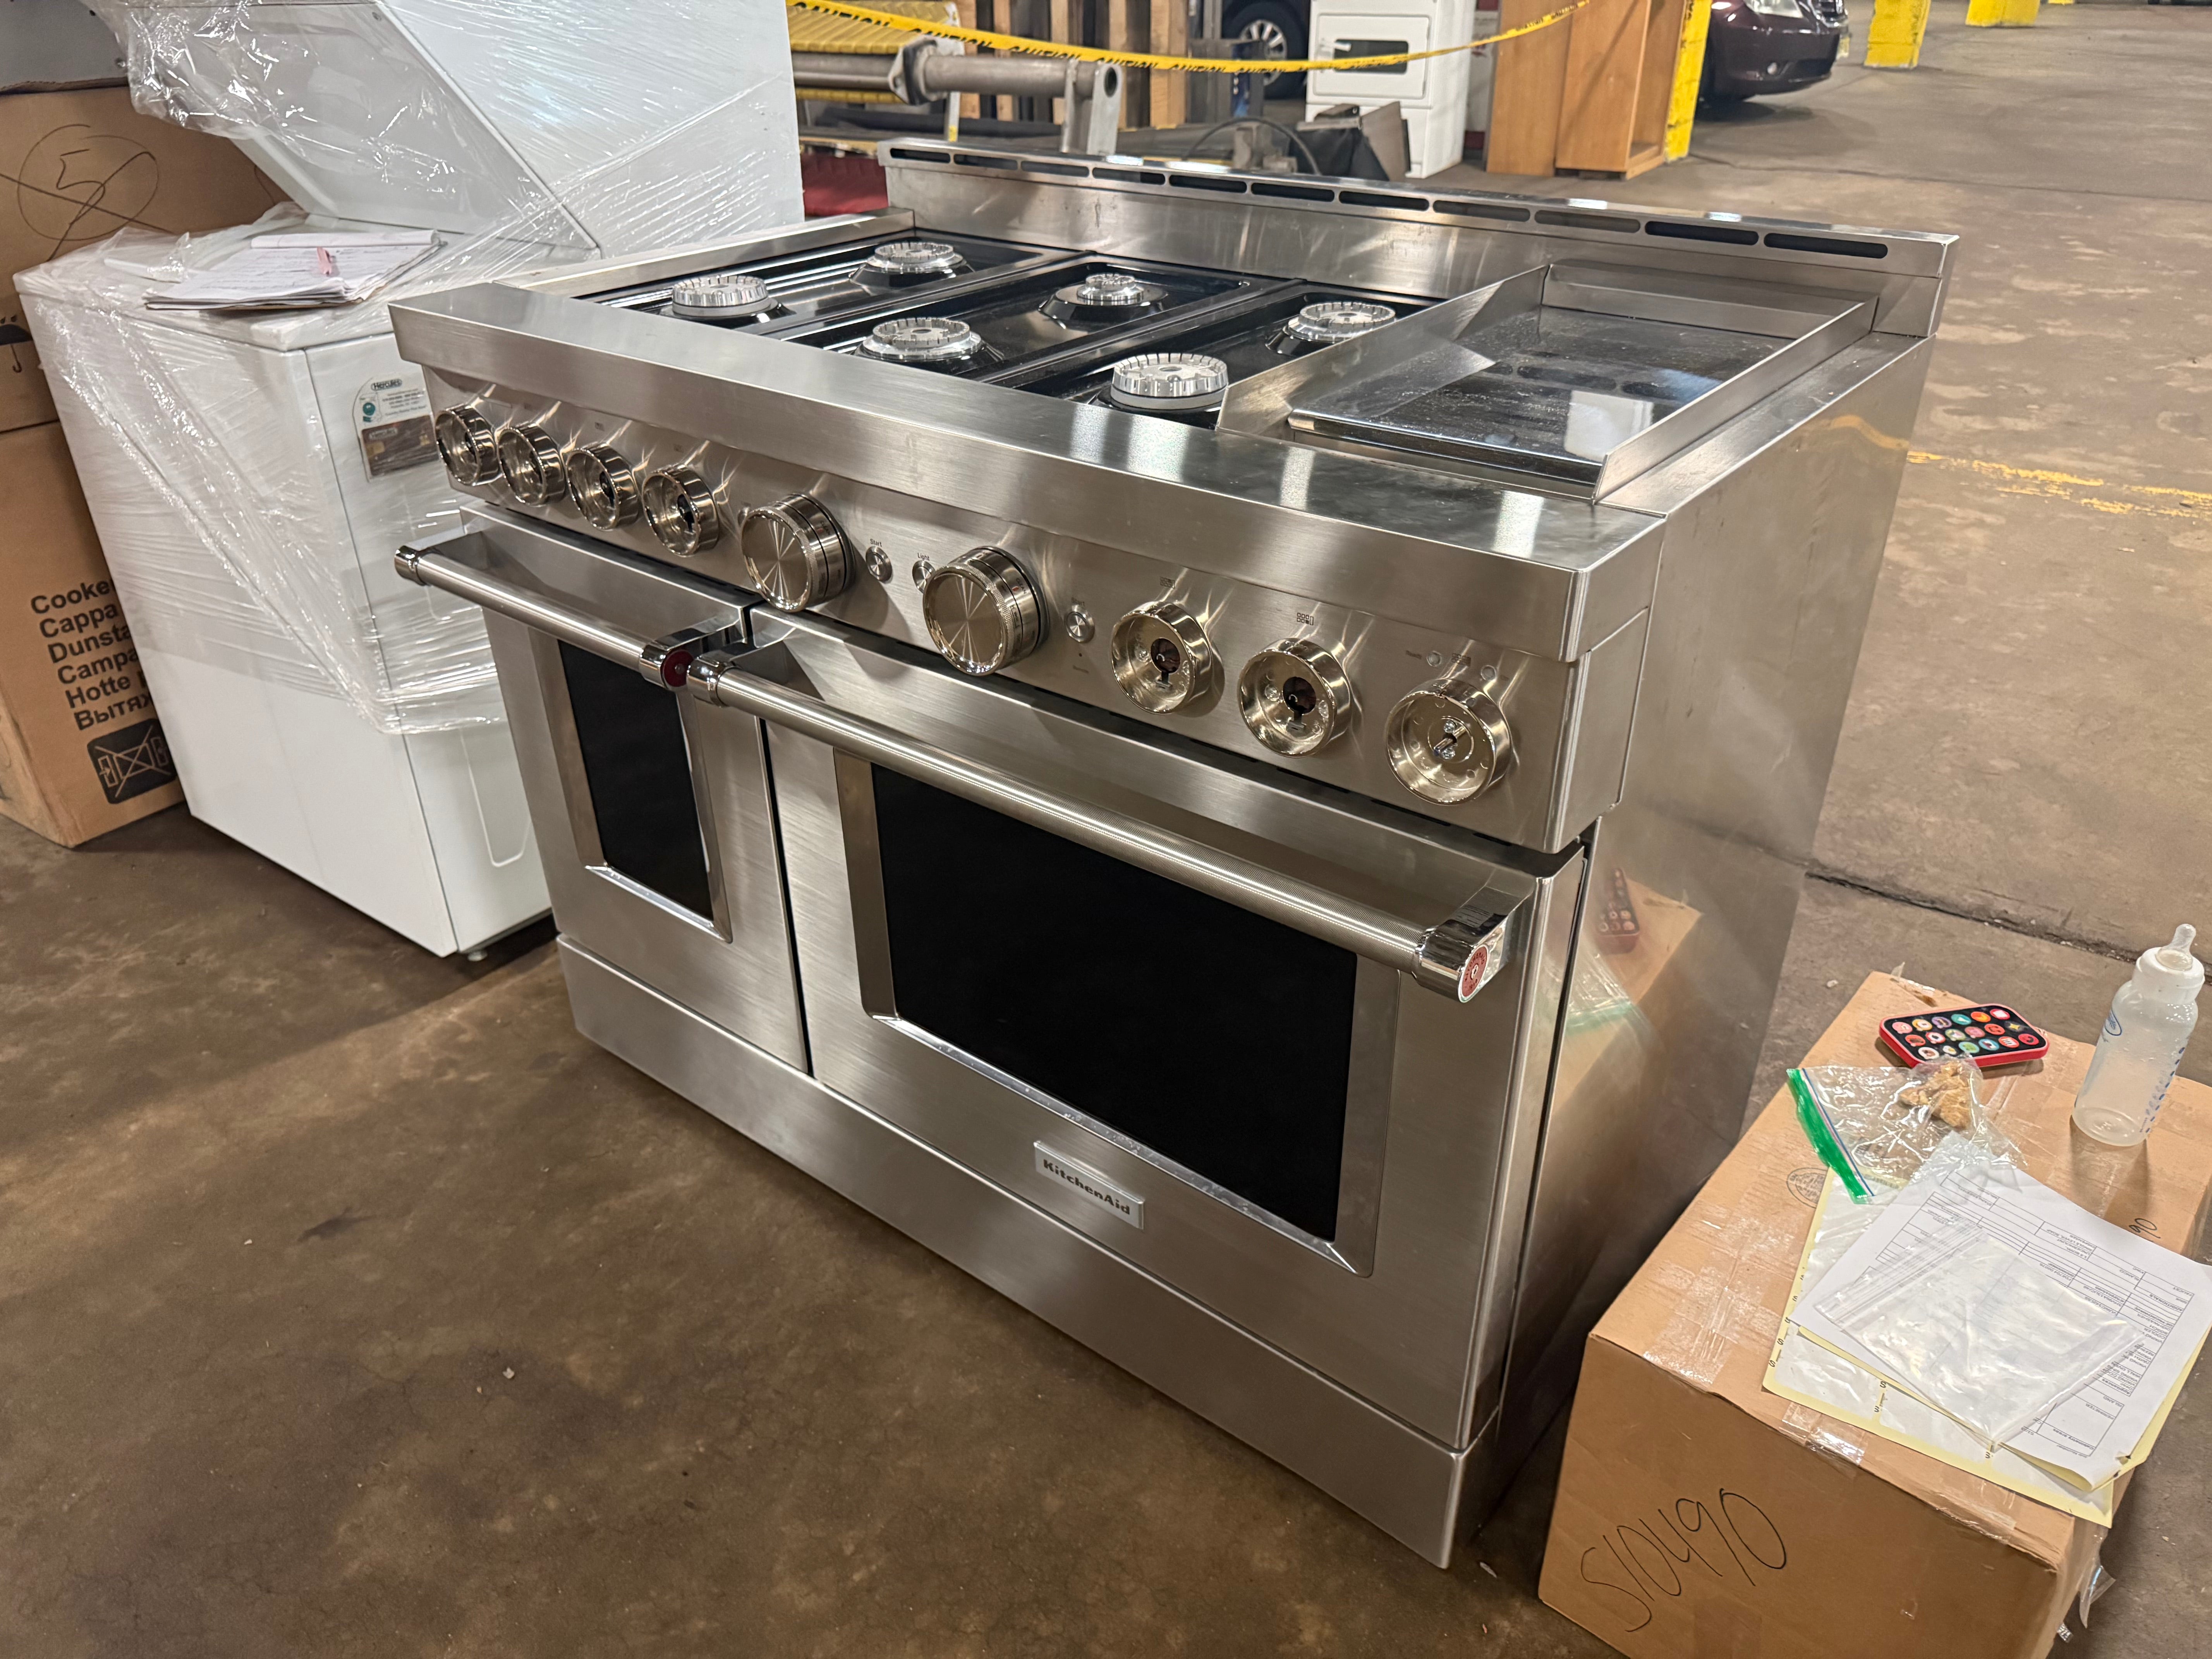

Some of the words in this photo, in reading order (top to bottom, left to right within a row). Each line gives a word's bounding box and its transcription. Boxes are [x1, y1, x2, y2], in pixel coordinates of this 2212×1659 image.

[870, 539, 883, 547] Start
[917, 552, 930, 561] Light
[31, 579, 116, 614] Cooke
[1071, 597, 1085, 606] Start
[40, 603, 118, 638] Cappa
[65, 676, 131, 709] Hotte
[1043, 1159, 1130, 1215] KitchenAid
[2136, 1312, 2170, 1332] DISHWASHER
[2149, 1324, 2167, 1336] BOSCH
[2102, 1395, 2122, 1408] ISLAND
[2085, 1403, 2114, 1420] PERIMETER
